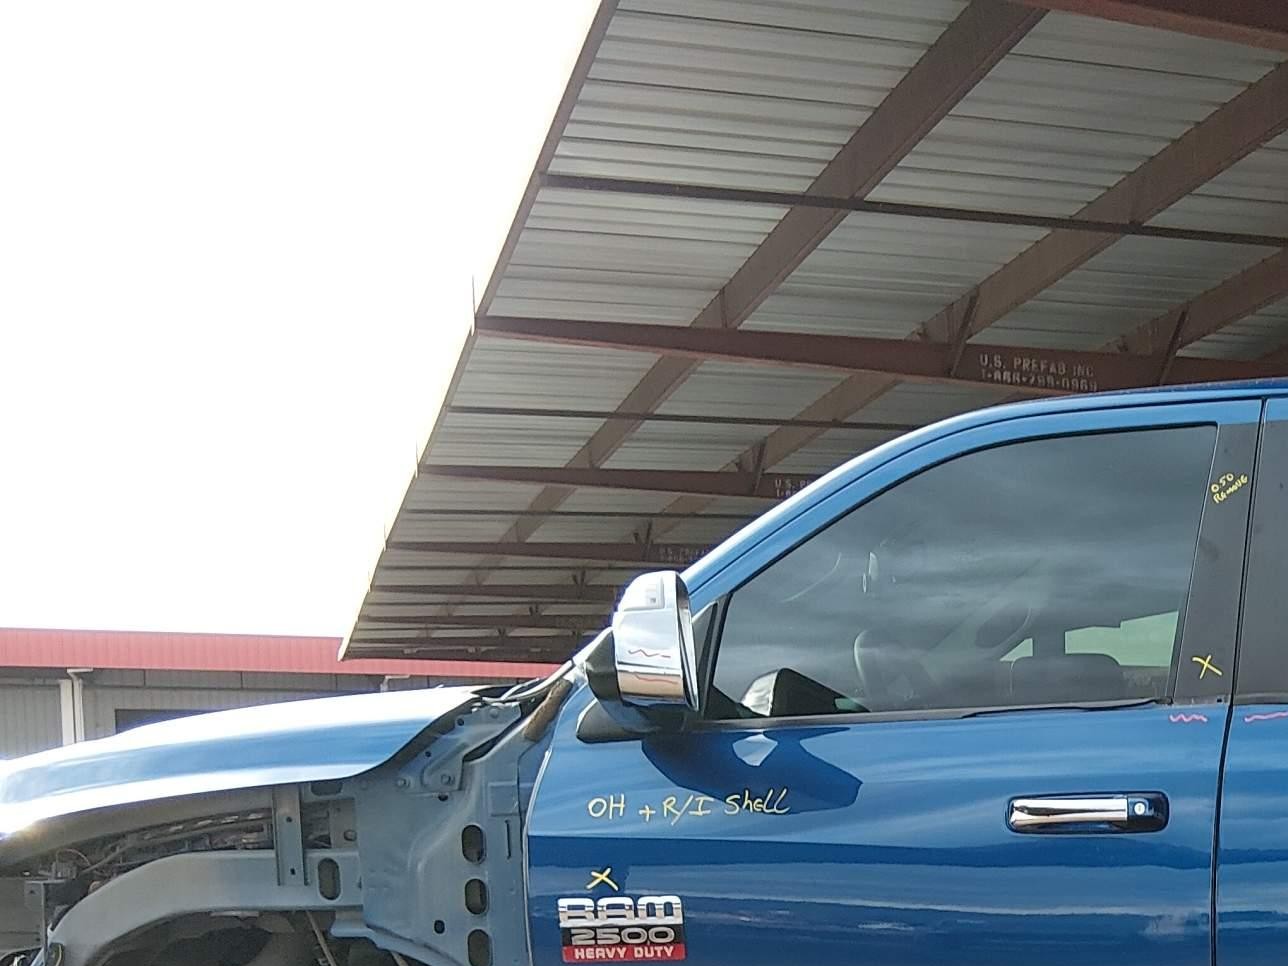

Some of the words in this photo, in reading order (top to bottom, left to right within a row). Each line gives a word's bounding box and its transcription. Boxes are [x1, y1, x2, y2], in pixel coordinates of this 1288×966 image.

[1013, 357, 1067, 376] PREFAB
[587, 794, 626, 820] OH
[558, 895, 684, 928] RAM
[571, 926, 676, 946] 2500
[574, 947, 627, 960] HEAVY
[633, 946, 675, 959] DUTY
